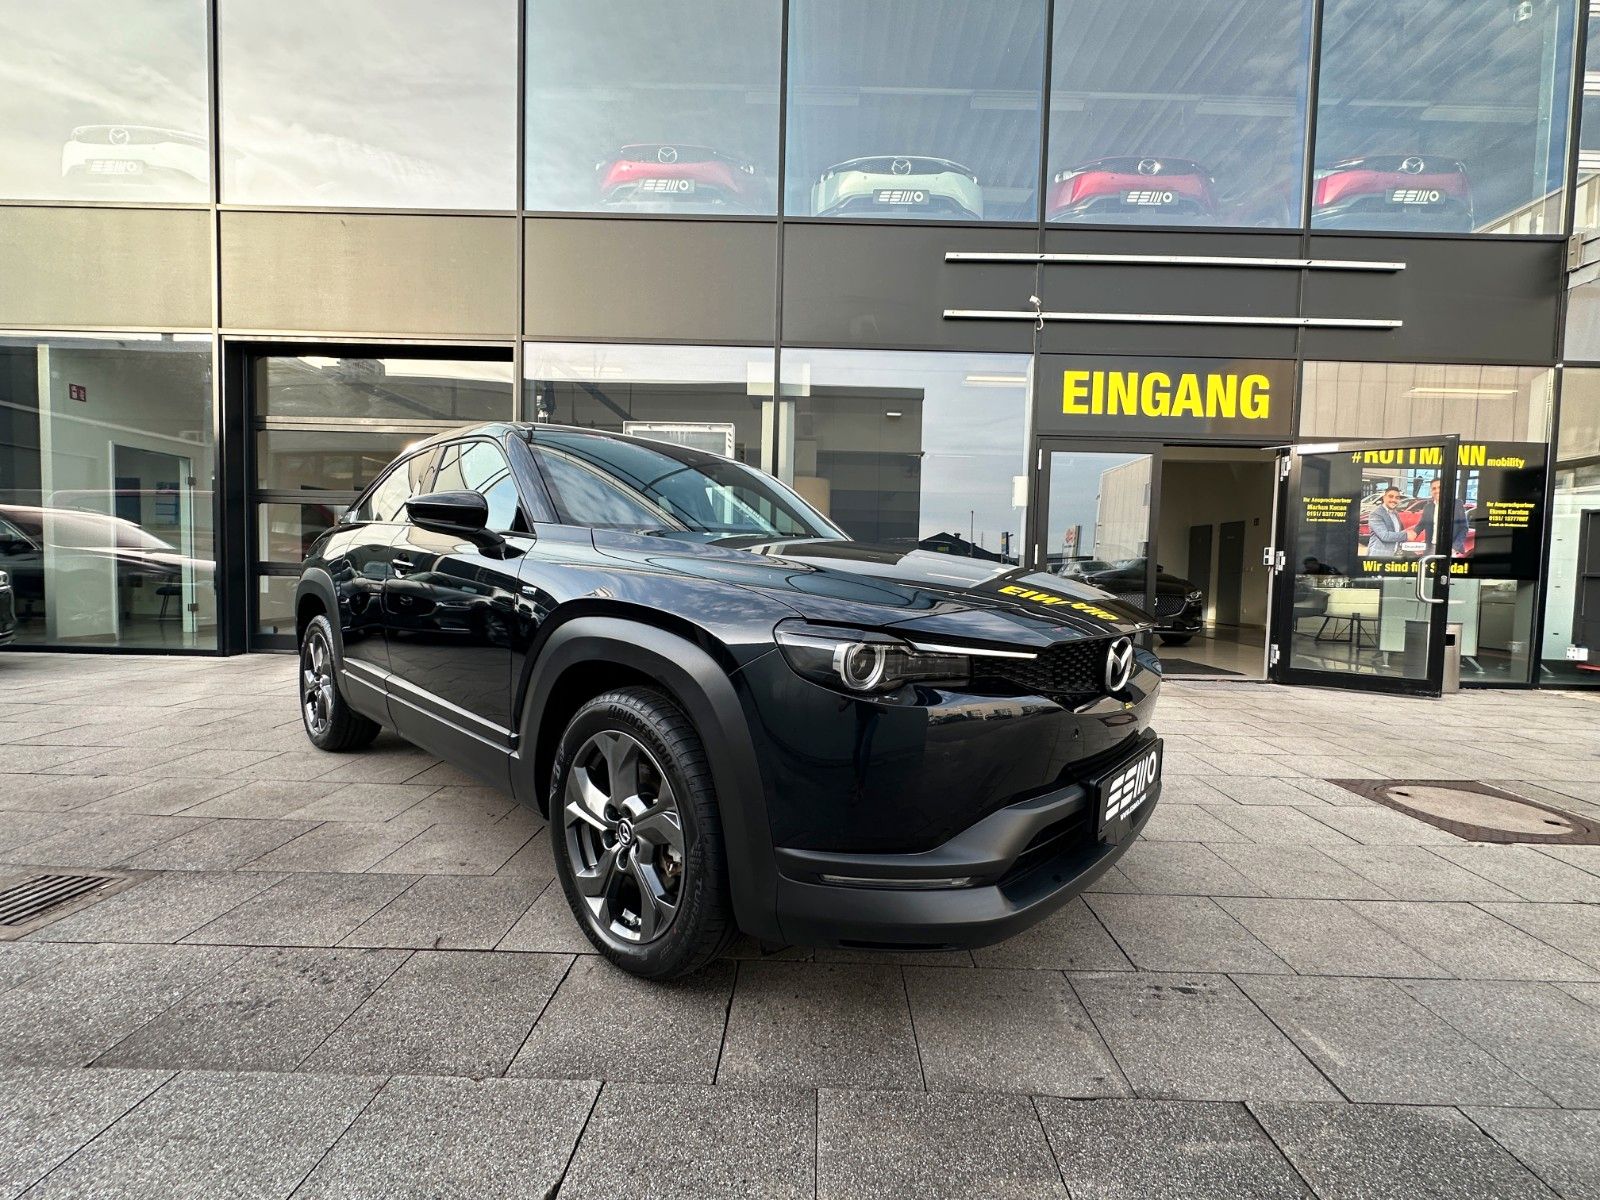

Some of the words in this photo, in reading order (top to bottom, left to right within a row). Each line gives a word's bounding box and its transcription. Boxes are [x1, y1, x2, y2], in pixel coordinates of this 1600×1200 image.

[1062, 370, 1270, 419] EINGANG
[1352, 445, 1486, 467] #ROTTMNN
[1487, 457, 1526, 469] mobility
[1363, 561, 1382, 572] Wir
[1384, 561, 1409, 573] sind
[1450, 562, 1469, 574] da!
